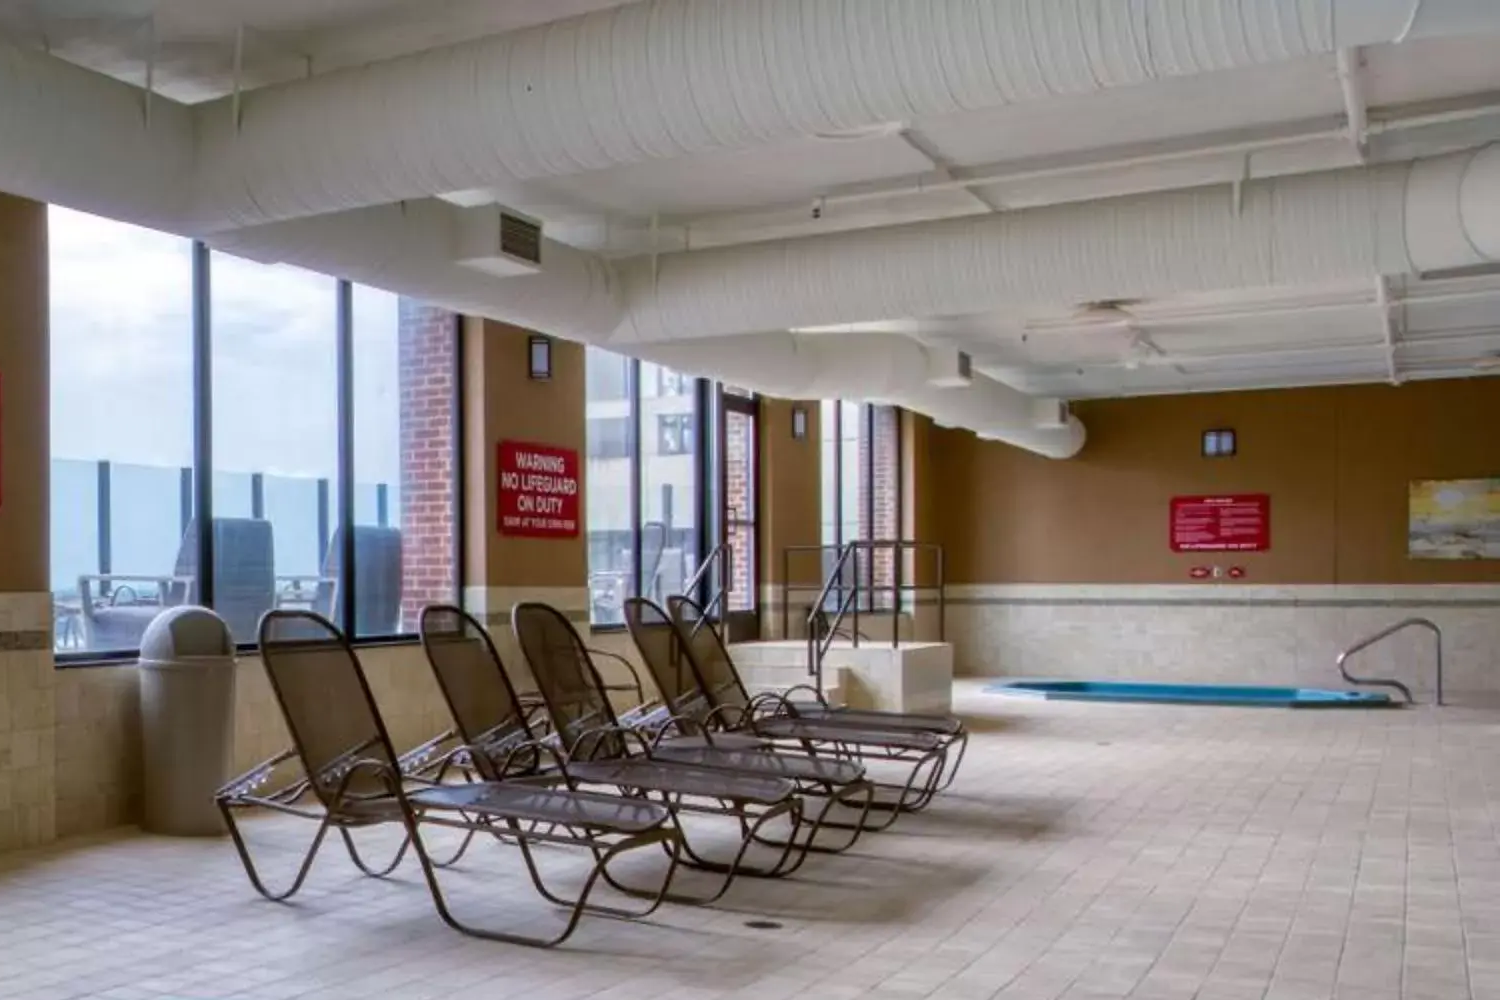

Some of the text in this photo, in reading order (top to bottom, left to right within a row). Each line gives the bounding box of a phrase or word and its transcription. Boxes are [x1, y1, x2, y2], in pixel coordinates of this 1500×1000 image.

[516, 452, 564, 474] WARNING
[502, 472, 577, 495] NO LIFEGUARD
[517, 495, 562, 513] ON DUTY
